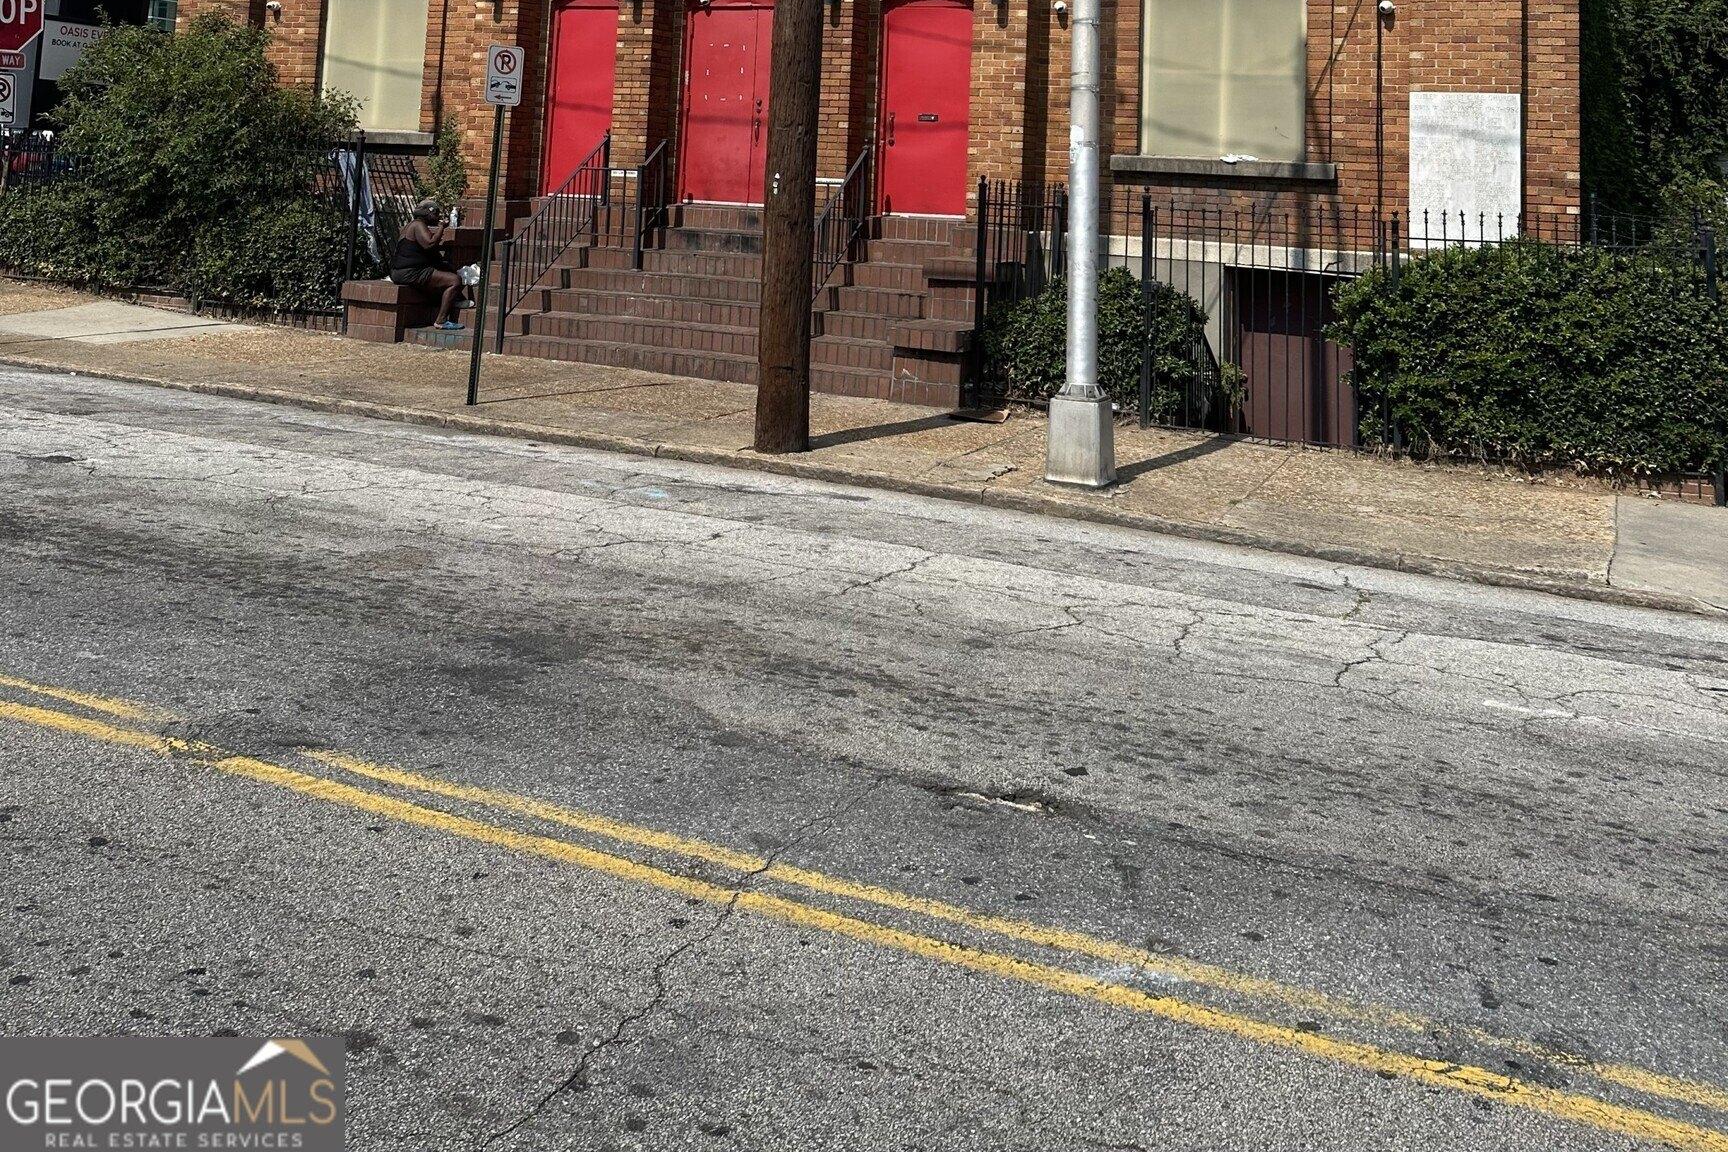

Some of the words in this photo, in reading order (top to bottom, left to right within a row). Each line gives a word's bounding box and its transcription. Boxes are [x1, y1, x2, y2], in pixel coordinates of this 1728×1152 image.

[60, 25, 89, 38] OASIS
[51, 38, 71, 47] BOOK
[1, 54, 21, 67] WAY
